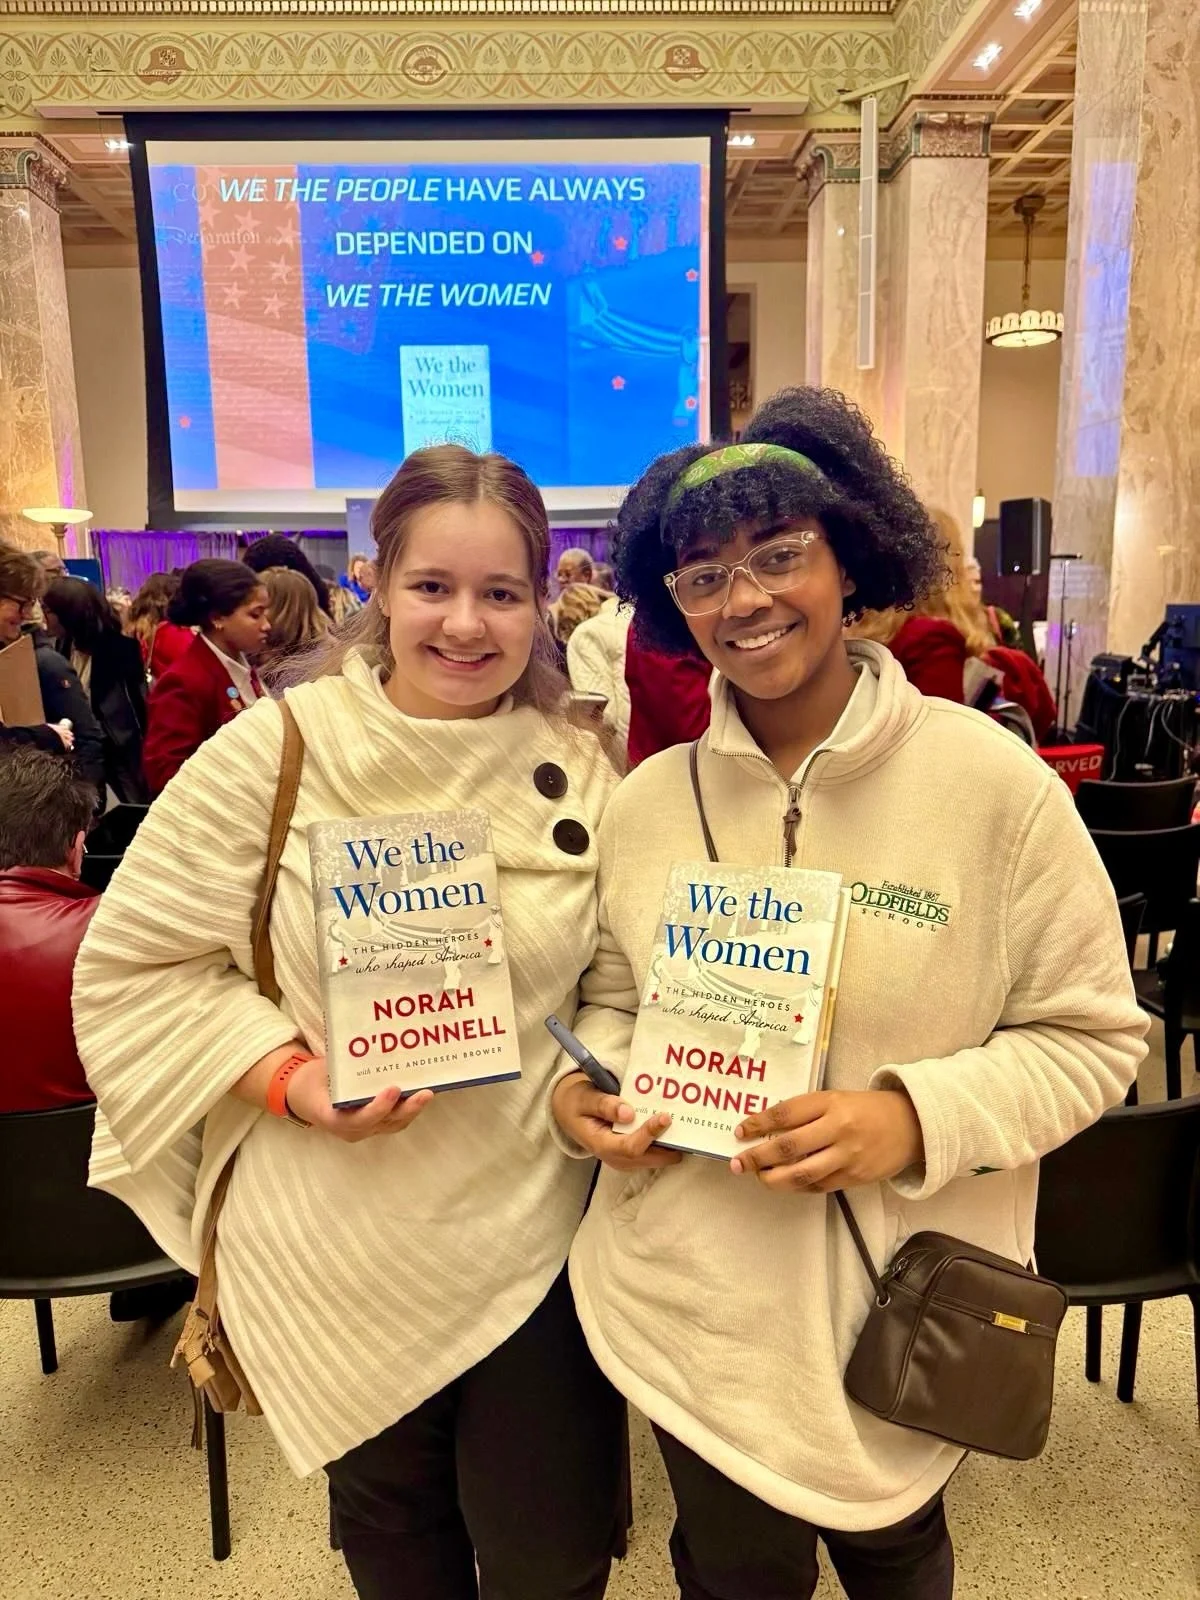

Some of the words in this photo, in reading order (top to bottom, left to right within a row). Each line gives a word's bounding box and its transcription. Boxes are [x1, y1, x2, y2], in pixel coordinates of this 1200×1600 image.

[219, 178, 267, 202] WE
[274, 178, 330, 202] THE
[336, 178, 442, 202] PEOPLE
[446, 177, 522, 201] HAVE
[528, 177, 646, 201] ALWAYS
[336, 231, 485, 255] DEPENDED
[492, 230, 533, 254] ON
[326, 284, 373, 307] WE
[379, 283, 434, 307] THE
[441, 282, 552, 306] WOMEN
[415, 357, 443, 374] We
[449, 356, 477, 374] the
[408, 379, 485, 398] Women
[1051, 755, 1103, 773] RVED
[344, 838, 401, 871] We
[411, 832, 466, 865] the
[329, 880, 487, 921] Women
[882, 880, 922, 897] Established
[687, 883, 737, 917] We
[749, 887, 803, 924] the
[861, 908, 937, 932] SCHOOL
[353, 945, 375, 955] THE
[382, 939, 429, 951] HIDDEN
[436, 932, 480, 945] HEROES
[664, 923, 811, 977] Women
[355, 956, 381, 974] who
[385, 952, 427, 972] shaped
[431, 946, 482, 965] America
[373, 987, 475, 1021] NORAH
[666, 986, 686, 996] THE
[692, 990, 737, 1003] HIDDEN
[744, 998, 791, 1012] HEROES
[662, 1000, 685, 1015] who
[688, 1003, 732, 1024] shaped
[733, 1010, 789, 1032] America
[348, 1016, 507, 1059] O'DONNELL
[356, 1068, 372, 1077] with
[375, 1063, 401, 1073] KATE
[406, 1053, 459, 1068] ANDERSEN
[463, 1046, 503, 1059] BROWER
[664, 1043, 767, 1083] NORAH
[634, 1073, 777, 1116] O'DONNEL
[653, 1109, 676, 1120] KE
[680, 1115, 733, 1132] ANDERSEN
